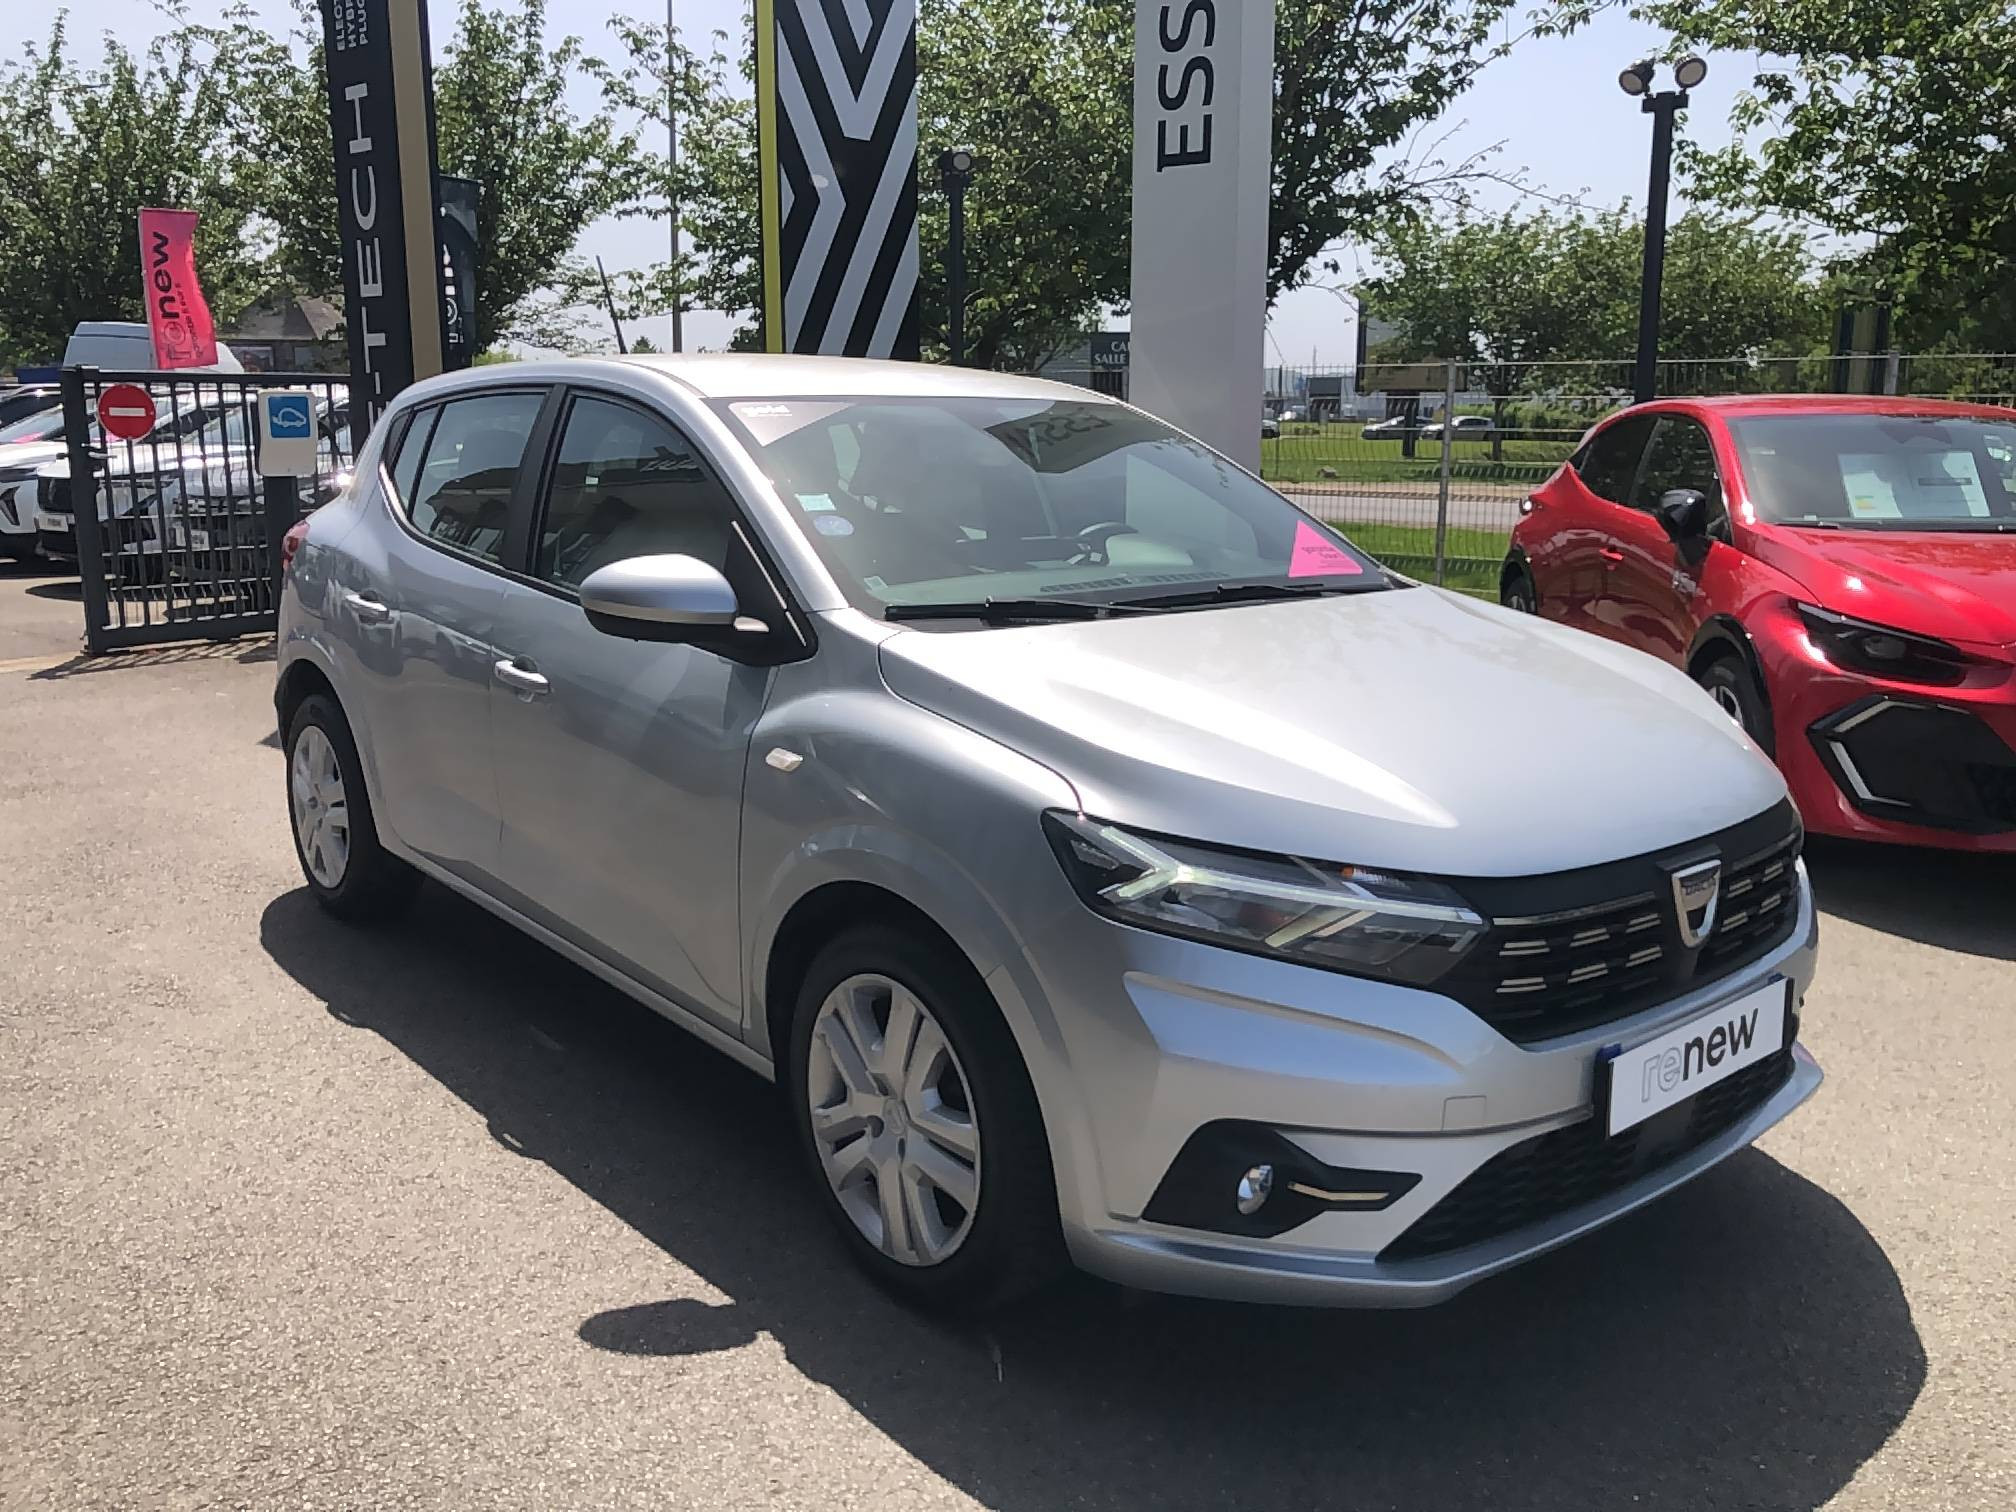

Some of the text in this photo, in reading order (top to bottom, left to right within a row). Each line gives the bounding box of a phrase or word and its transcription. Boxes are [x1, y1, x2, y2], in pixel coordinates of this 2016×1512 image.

[1157, 0, 1216, 172] ESS
[152, 231, 192, 360] renew
[1094, 353, 1127, 365] SALLE
[1111, 341, 1130, 352] CA
[1641, 1008, 1759, 1102] renew
